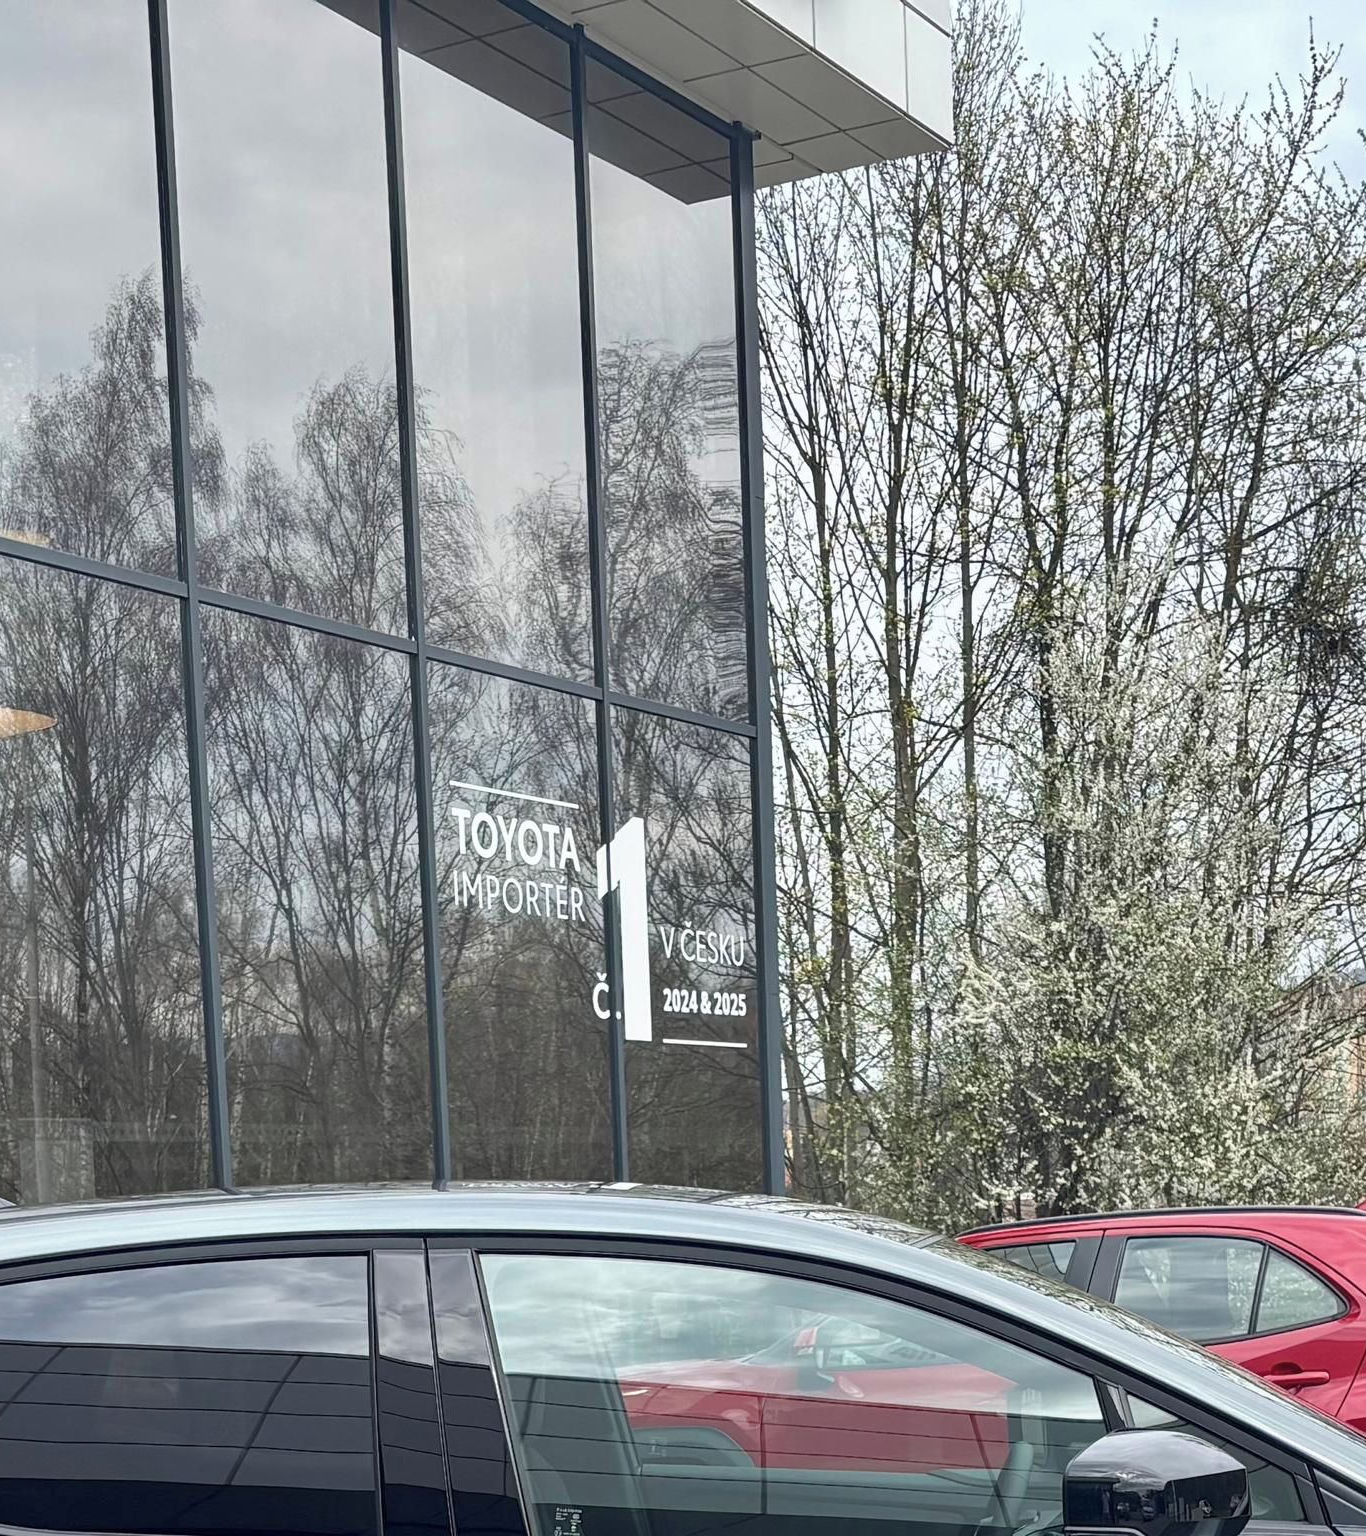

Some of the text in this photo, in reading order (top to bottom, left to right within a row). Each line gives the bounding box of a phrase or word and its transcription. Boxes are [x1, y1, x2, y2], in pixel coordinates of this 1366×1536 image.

[451, 807, 581, 872] TOYOTA
[452, 870, 585, 922] IMPORTÉR
[661, 921, 745, 966] V ČESKU
[663, 988, 747, 1017] 2024 & 2025
